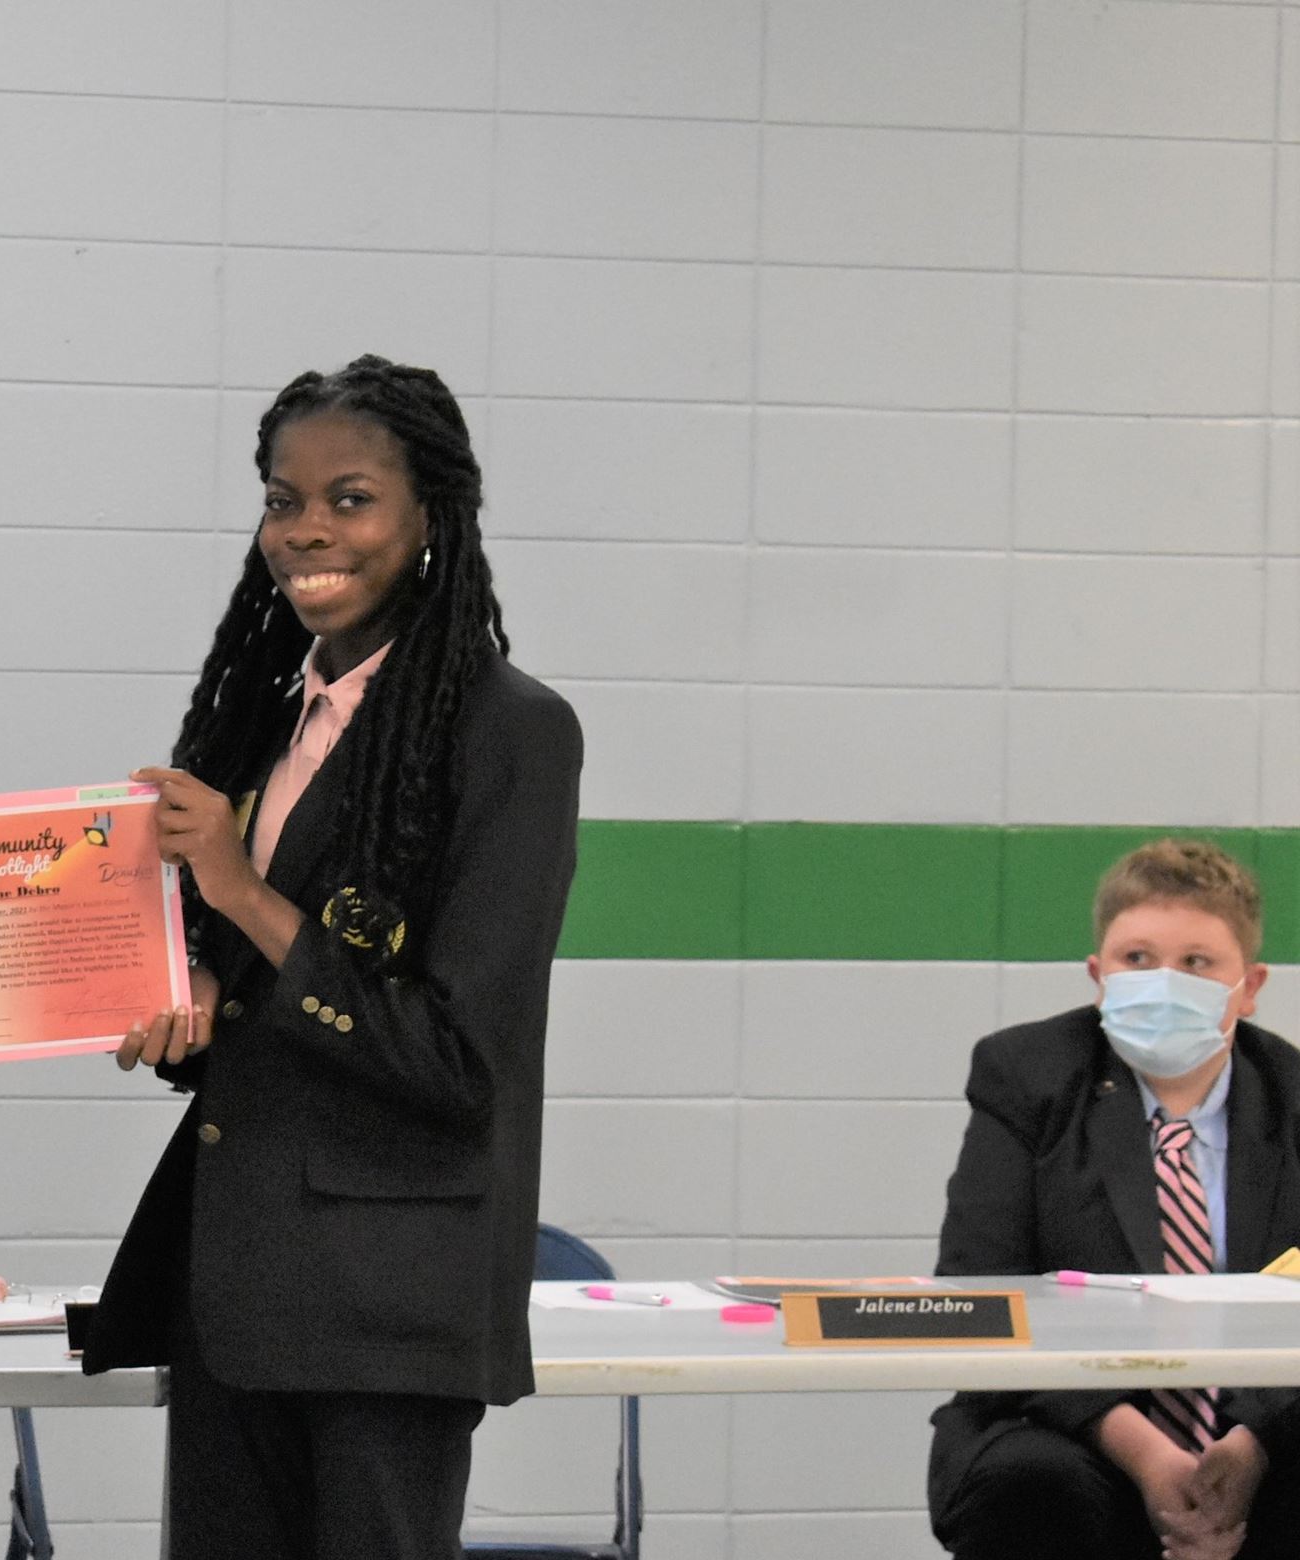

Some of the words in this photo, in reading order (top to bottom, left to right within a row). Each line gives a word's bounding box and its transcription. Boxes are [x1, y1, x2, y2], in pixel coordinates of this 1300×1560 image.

[17, 885, 61, 897] Debro
[855, 1298, 915, 1313] Jalene
[918, 1298, 975, 1313] Debro
